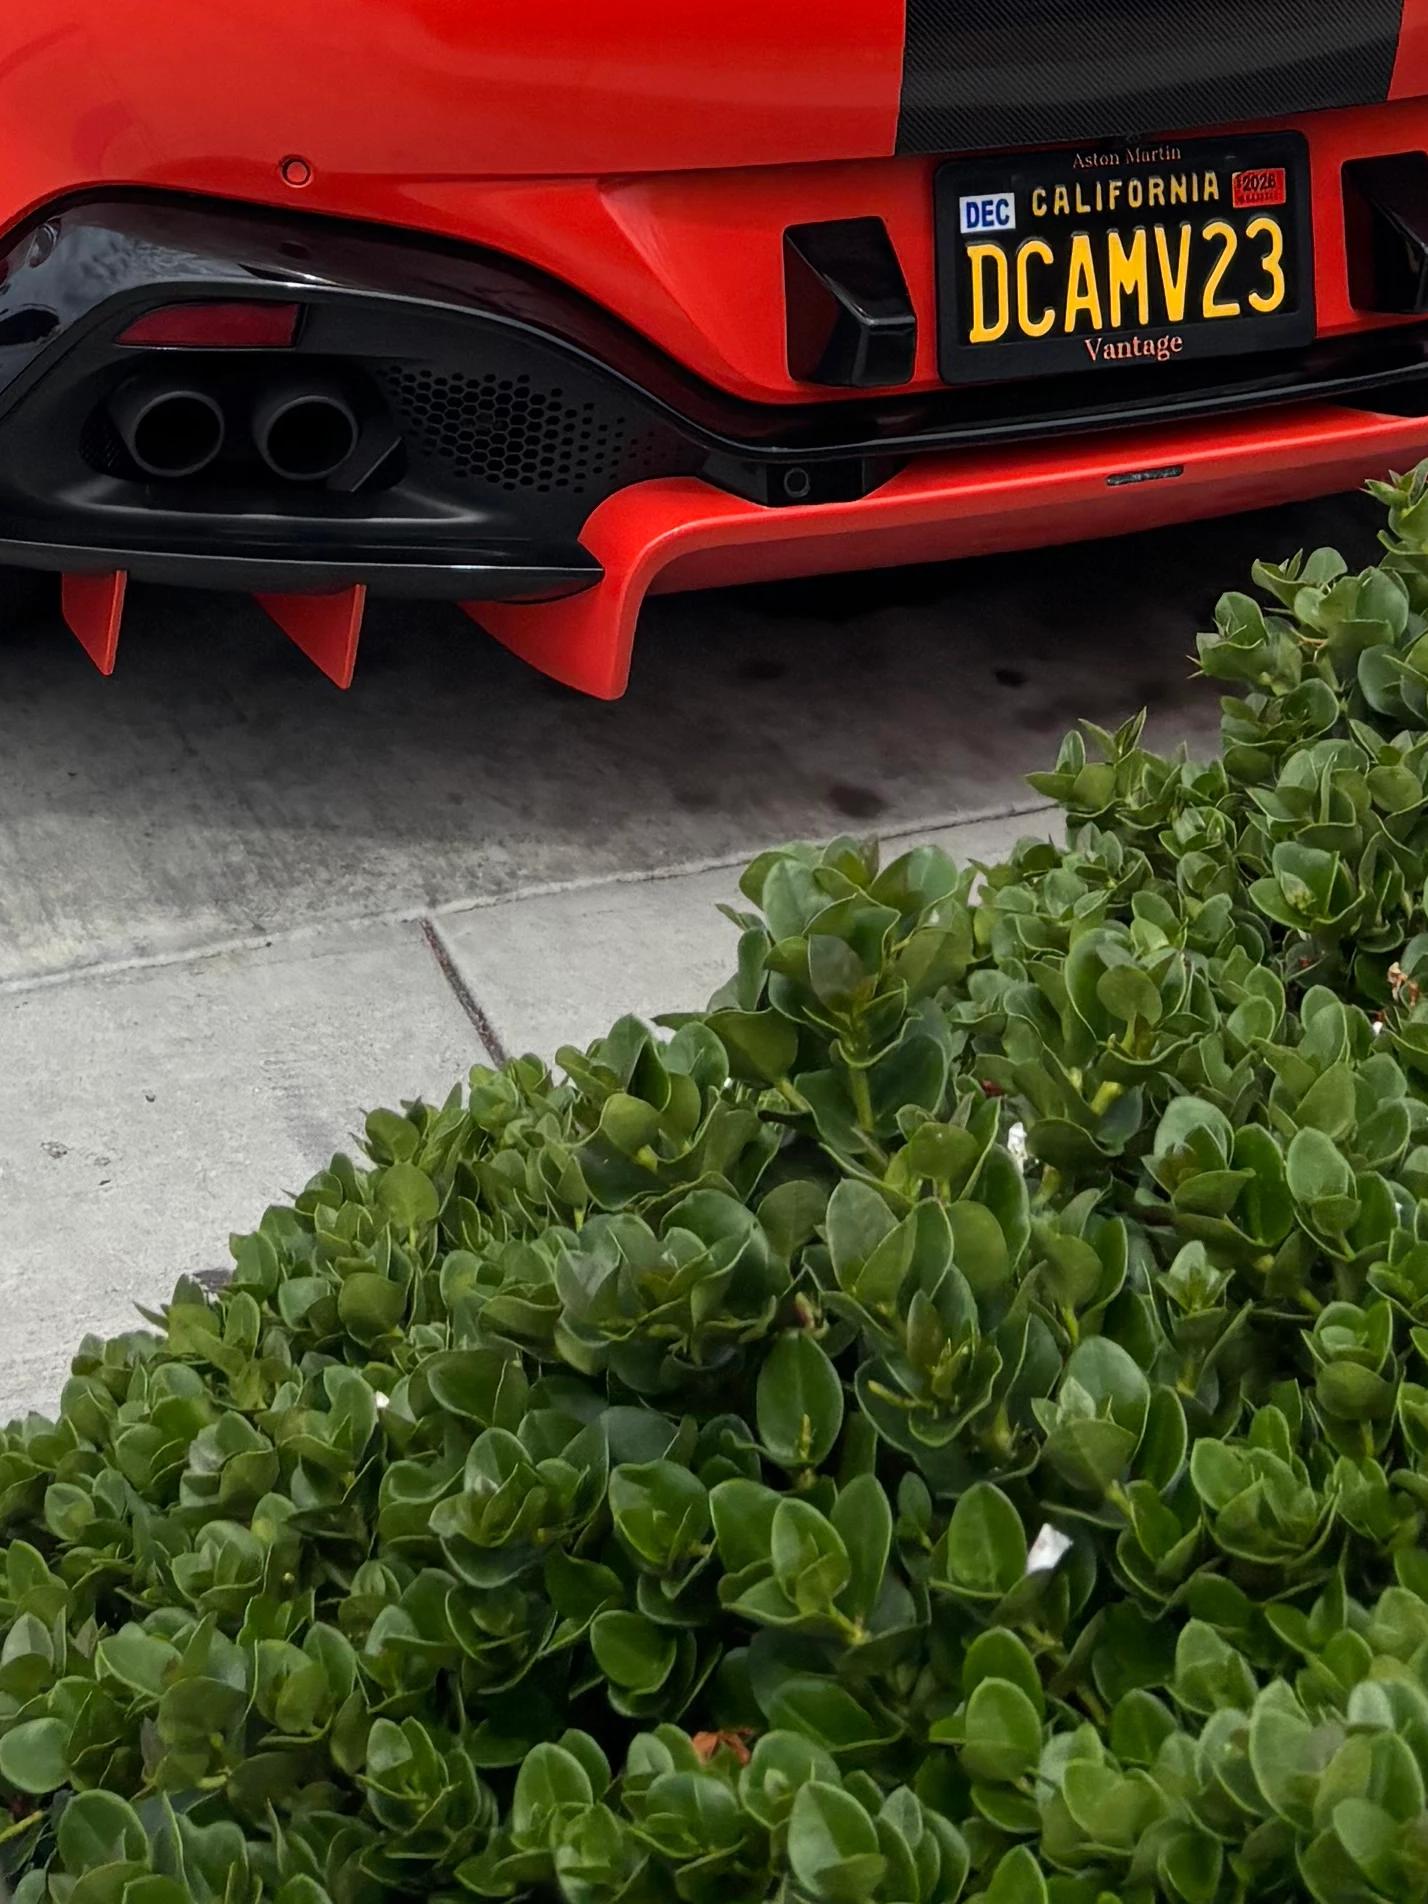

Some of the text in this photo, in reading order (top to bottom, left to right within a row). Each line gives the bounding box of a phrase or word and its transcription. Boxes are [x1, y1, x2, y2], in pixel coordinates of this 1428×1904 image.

[1072, 144, 1182, 169] Aston Martin
[1031, 171, 1220, 218] CALIFORNIA
[965, 197, 1011, 230] DEC
[965, 217, 1286, 344] DCAMV23
[1084, 333, 1184, 363] Vantage
